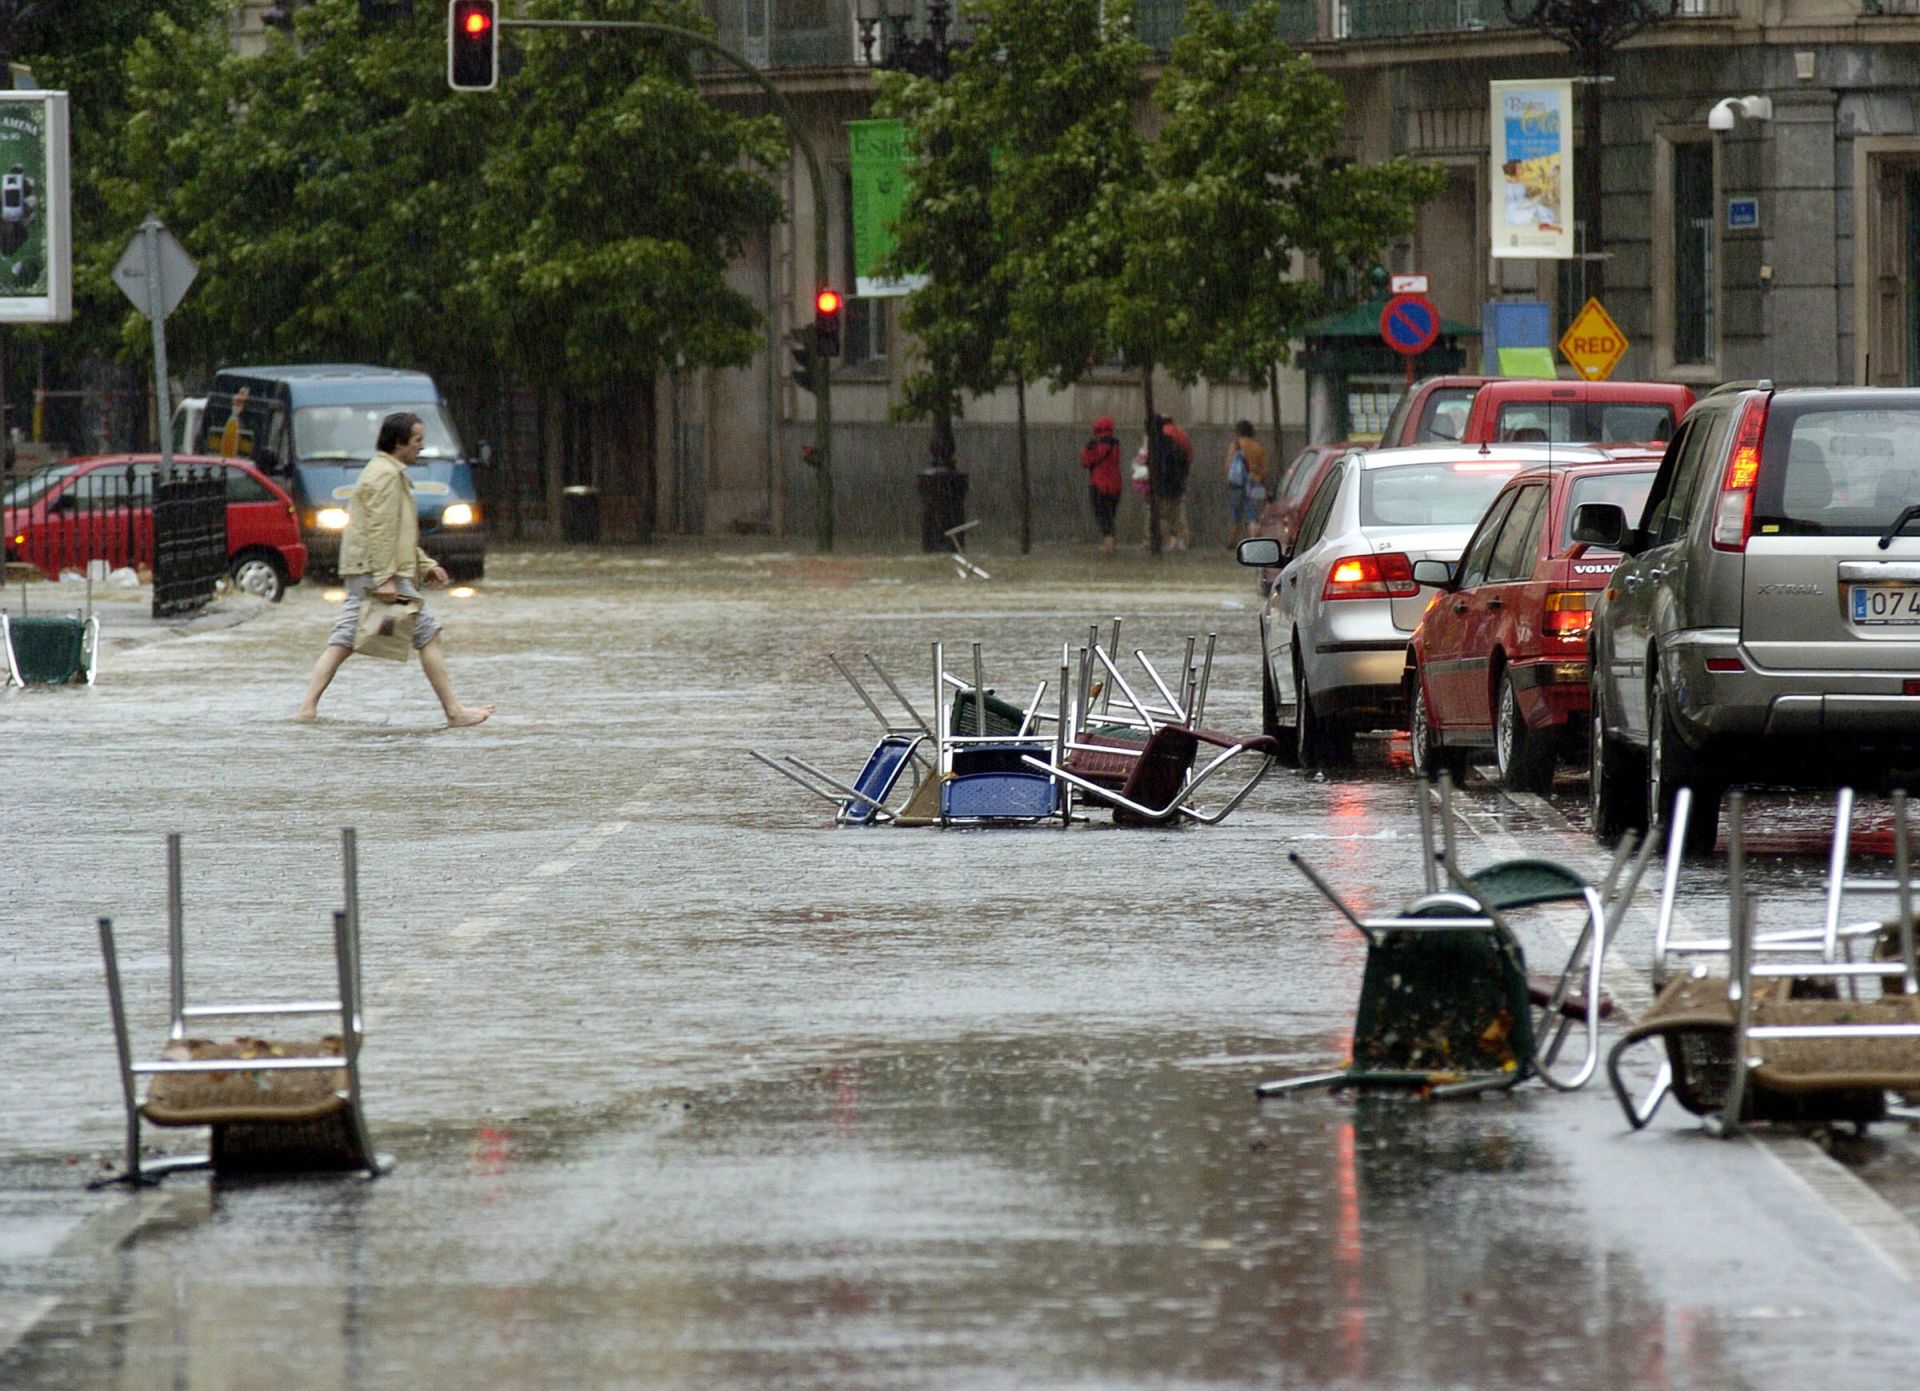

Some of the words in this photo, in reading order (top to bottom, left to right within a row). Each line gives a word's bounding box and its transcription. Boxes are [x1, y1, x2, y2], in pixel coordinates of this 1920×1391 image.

[1574, 337, 1616, 354] RED
[1574, 564, 1618, 574] VOLV
[1758, 583, 1824, 596] X-TRAIL
